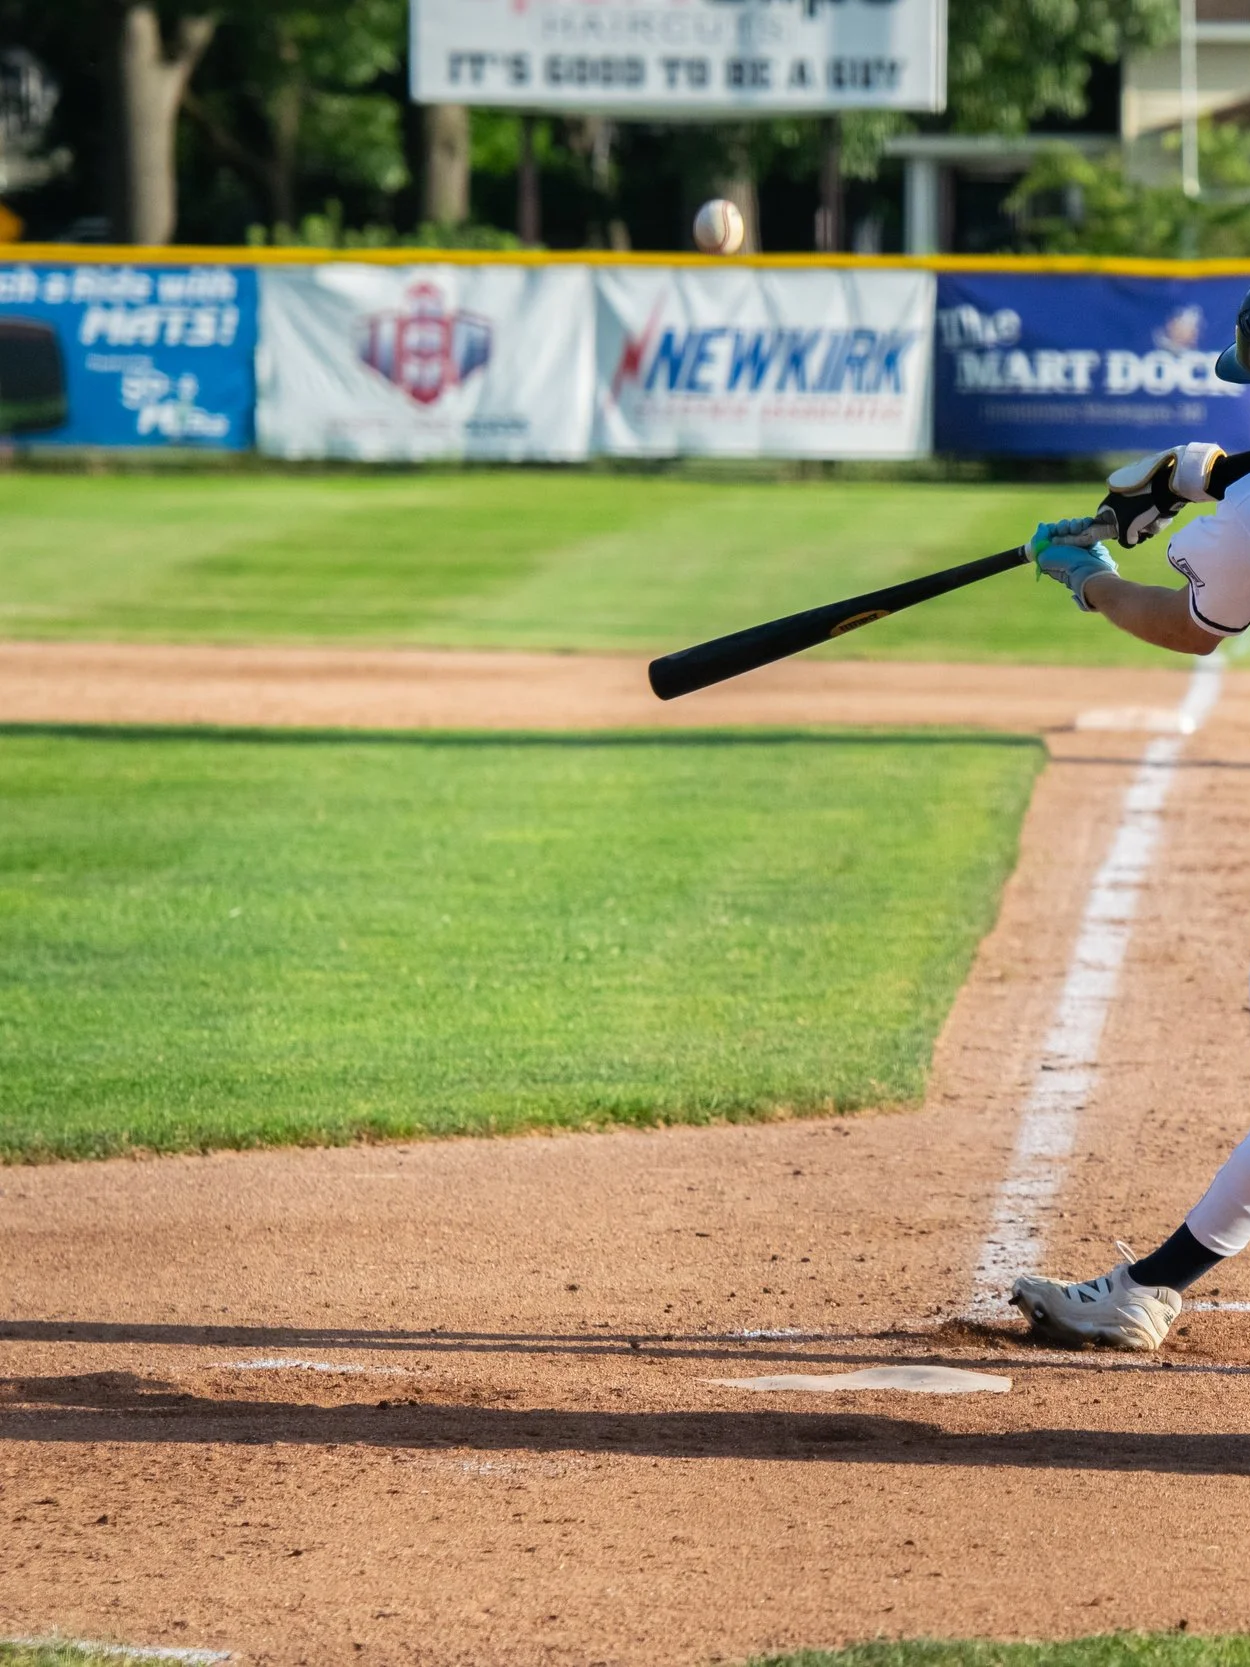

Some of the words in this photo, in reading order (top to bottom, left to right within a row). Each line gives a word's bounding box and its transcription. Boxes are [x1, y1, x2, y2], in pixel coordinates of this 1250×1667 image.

[448, 52, 529, 87] IT'S
[545, 55, 645, 88] GOOD
[661, 57, 710, 89] TO
[725, 59, 772, 89] BE
[788, 59, 815, 89] A
[643, 327, 924, 393] NEWKIRK
[955, 348, 1100, 394] MART
